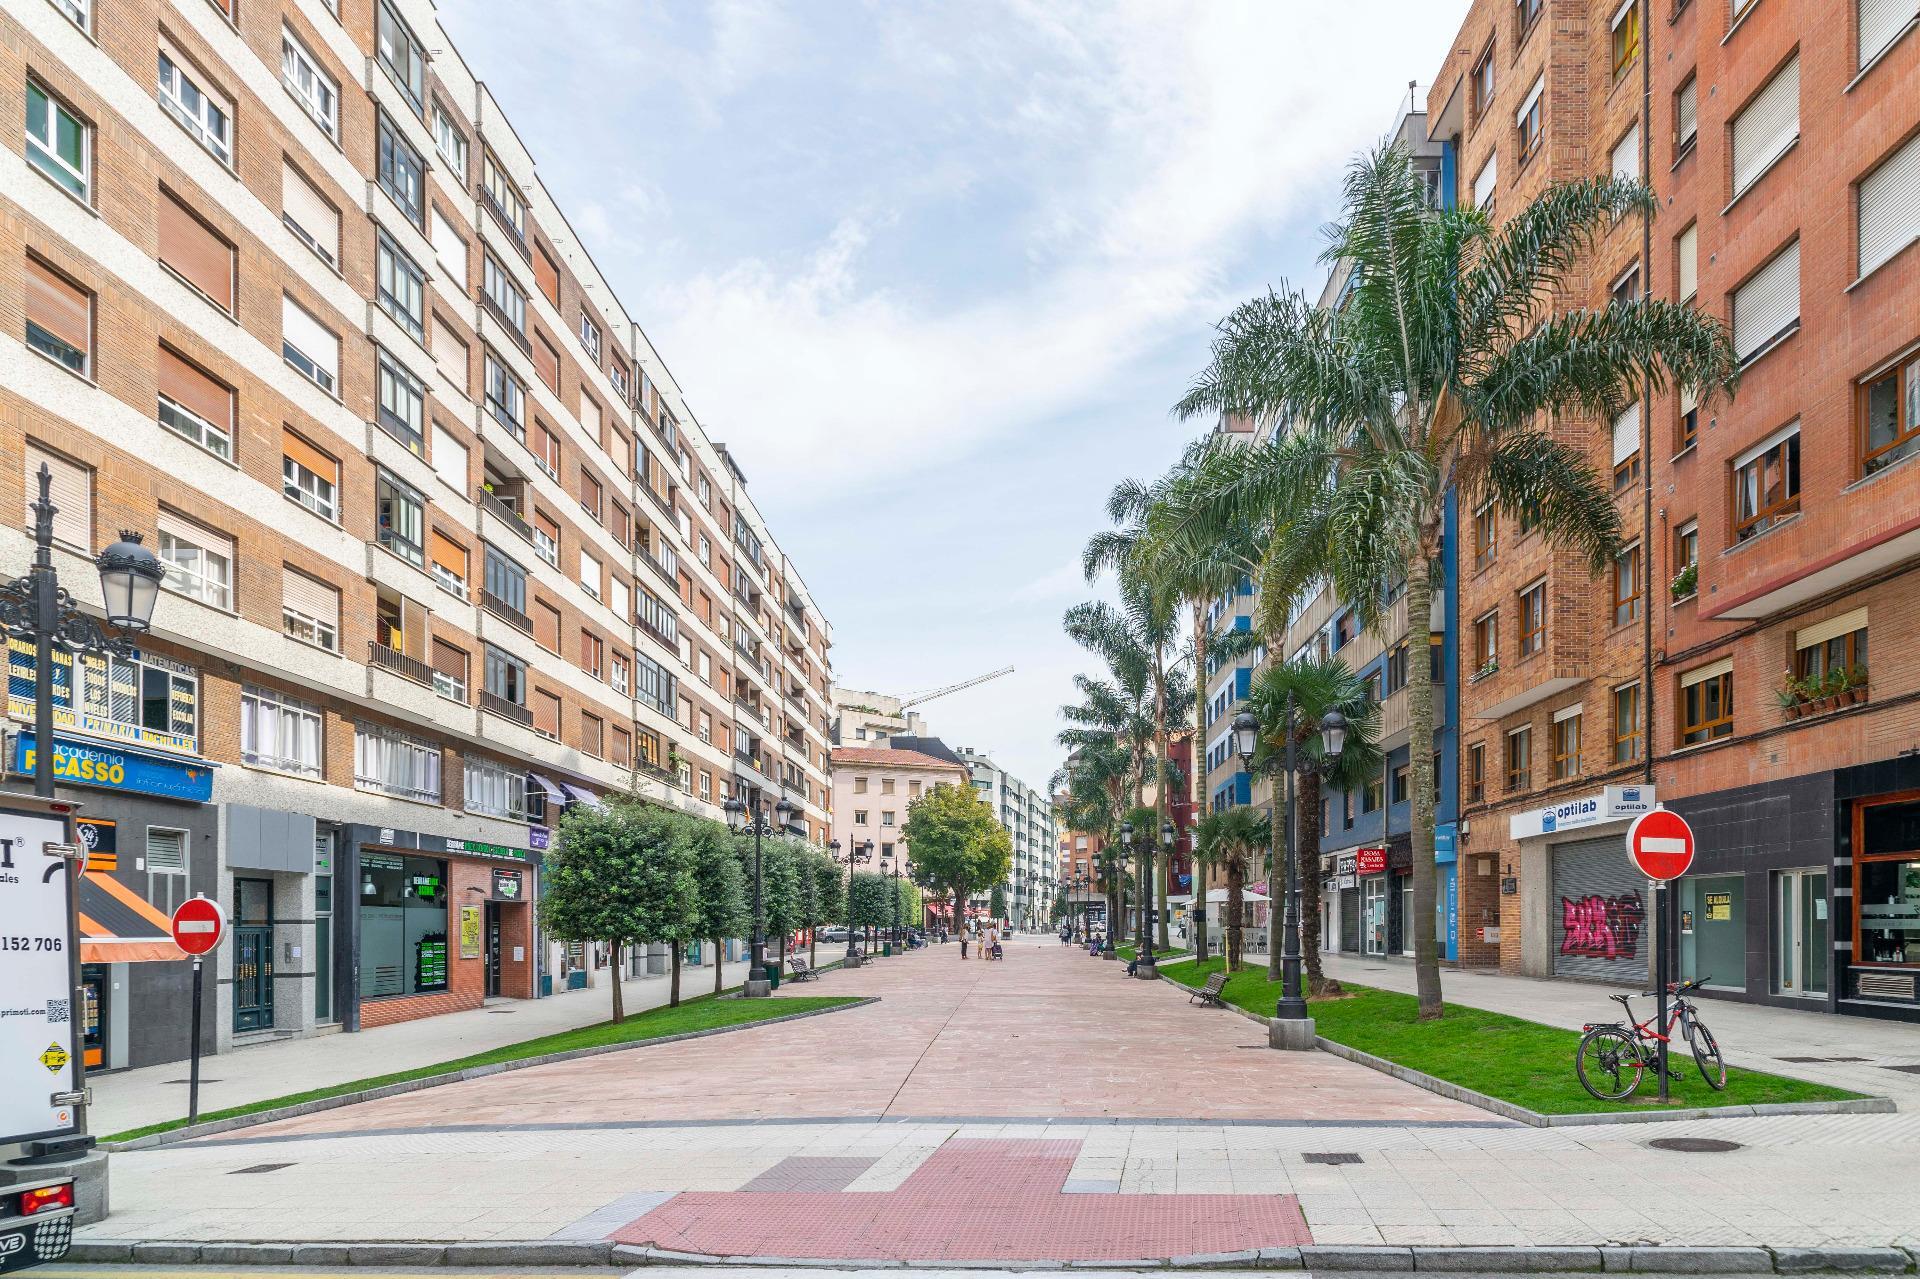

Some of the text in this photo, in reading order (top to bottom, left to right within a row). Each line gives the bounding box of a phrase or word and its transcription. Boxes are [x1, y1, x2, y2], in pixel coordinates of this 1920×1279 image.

[141, 651, 196, 676] MATEMATICAS
[86, 717, 135, 739] PRIMARIA
[53, 742, 124, 766] academia
[25, 749, 124, 784] PCASSO
[1557, 799, 1597, 819] optilab
[1615, 803, 1648, 811] optilab
[2, 936, 62, 951] 152 706
[1, 1007, 47, 1017] primoti.com
